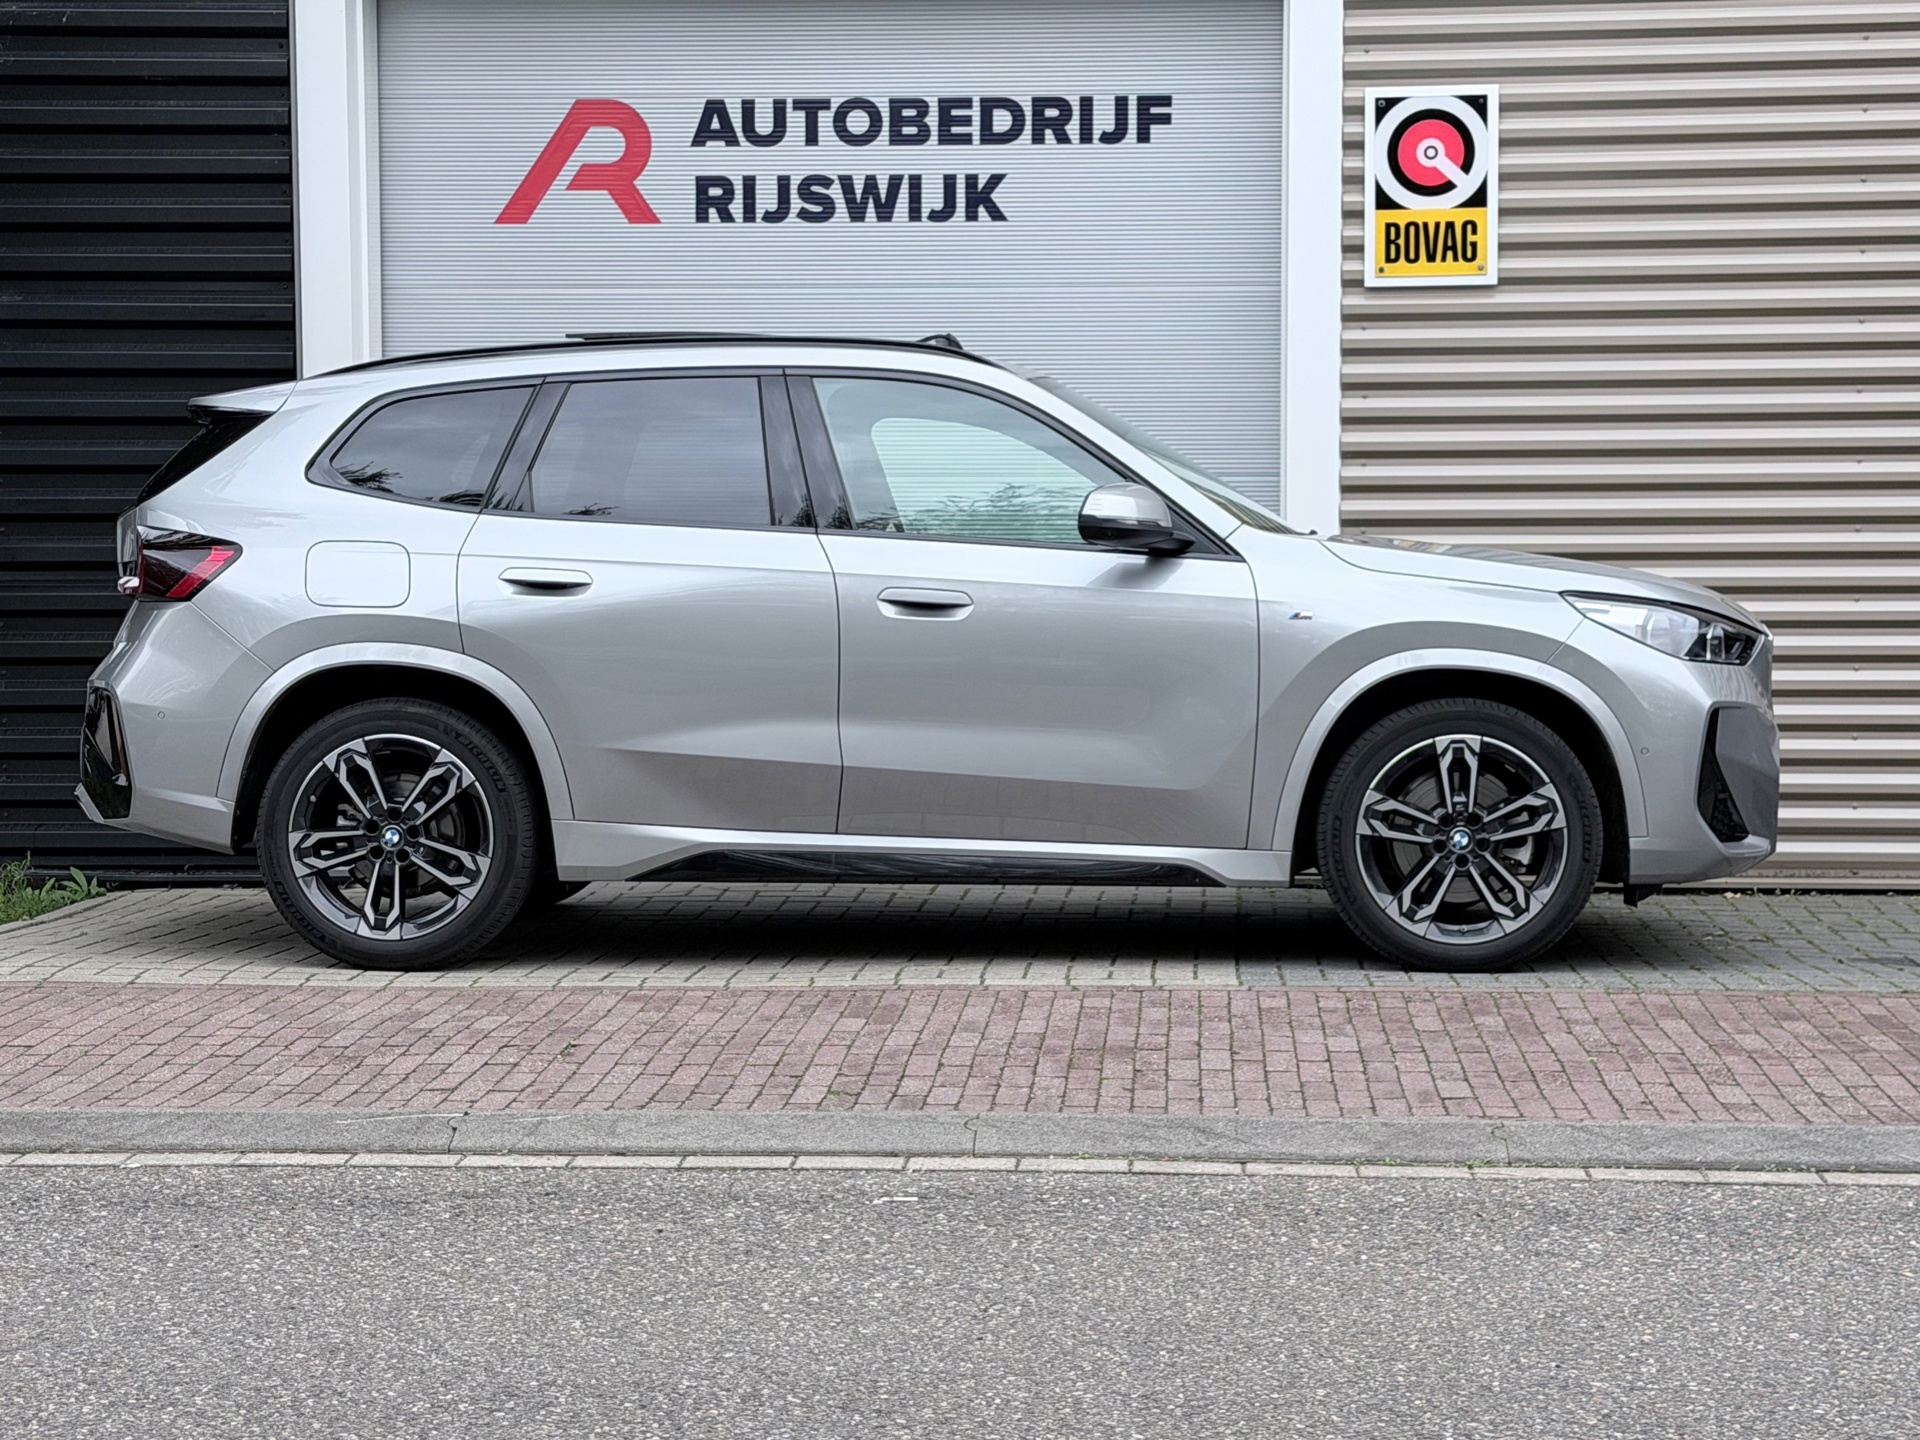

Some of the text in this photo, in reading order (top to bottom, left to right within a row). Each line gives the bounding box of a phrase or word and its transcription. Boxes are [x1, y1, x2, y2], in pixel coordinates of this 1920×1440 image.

[691, 96, 1172, 147] AUTOBEDRIJF
[696, 174, 1007, 223] RIJSWIJK
[1386, 221, 1477, 263] BOVAG
[455, 733, 506, 792] MICHELIN
